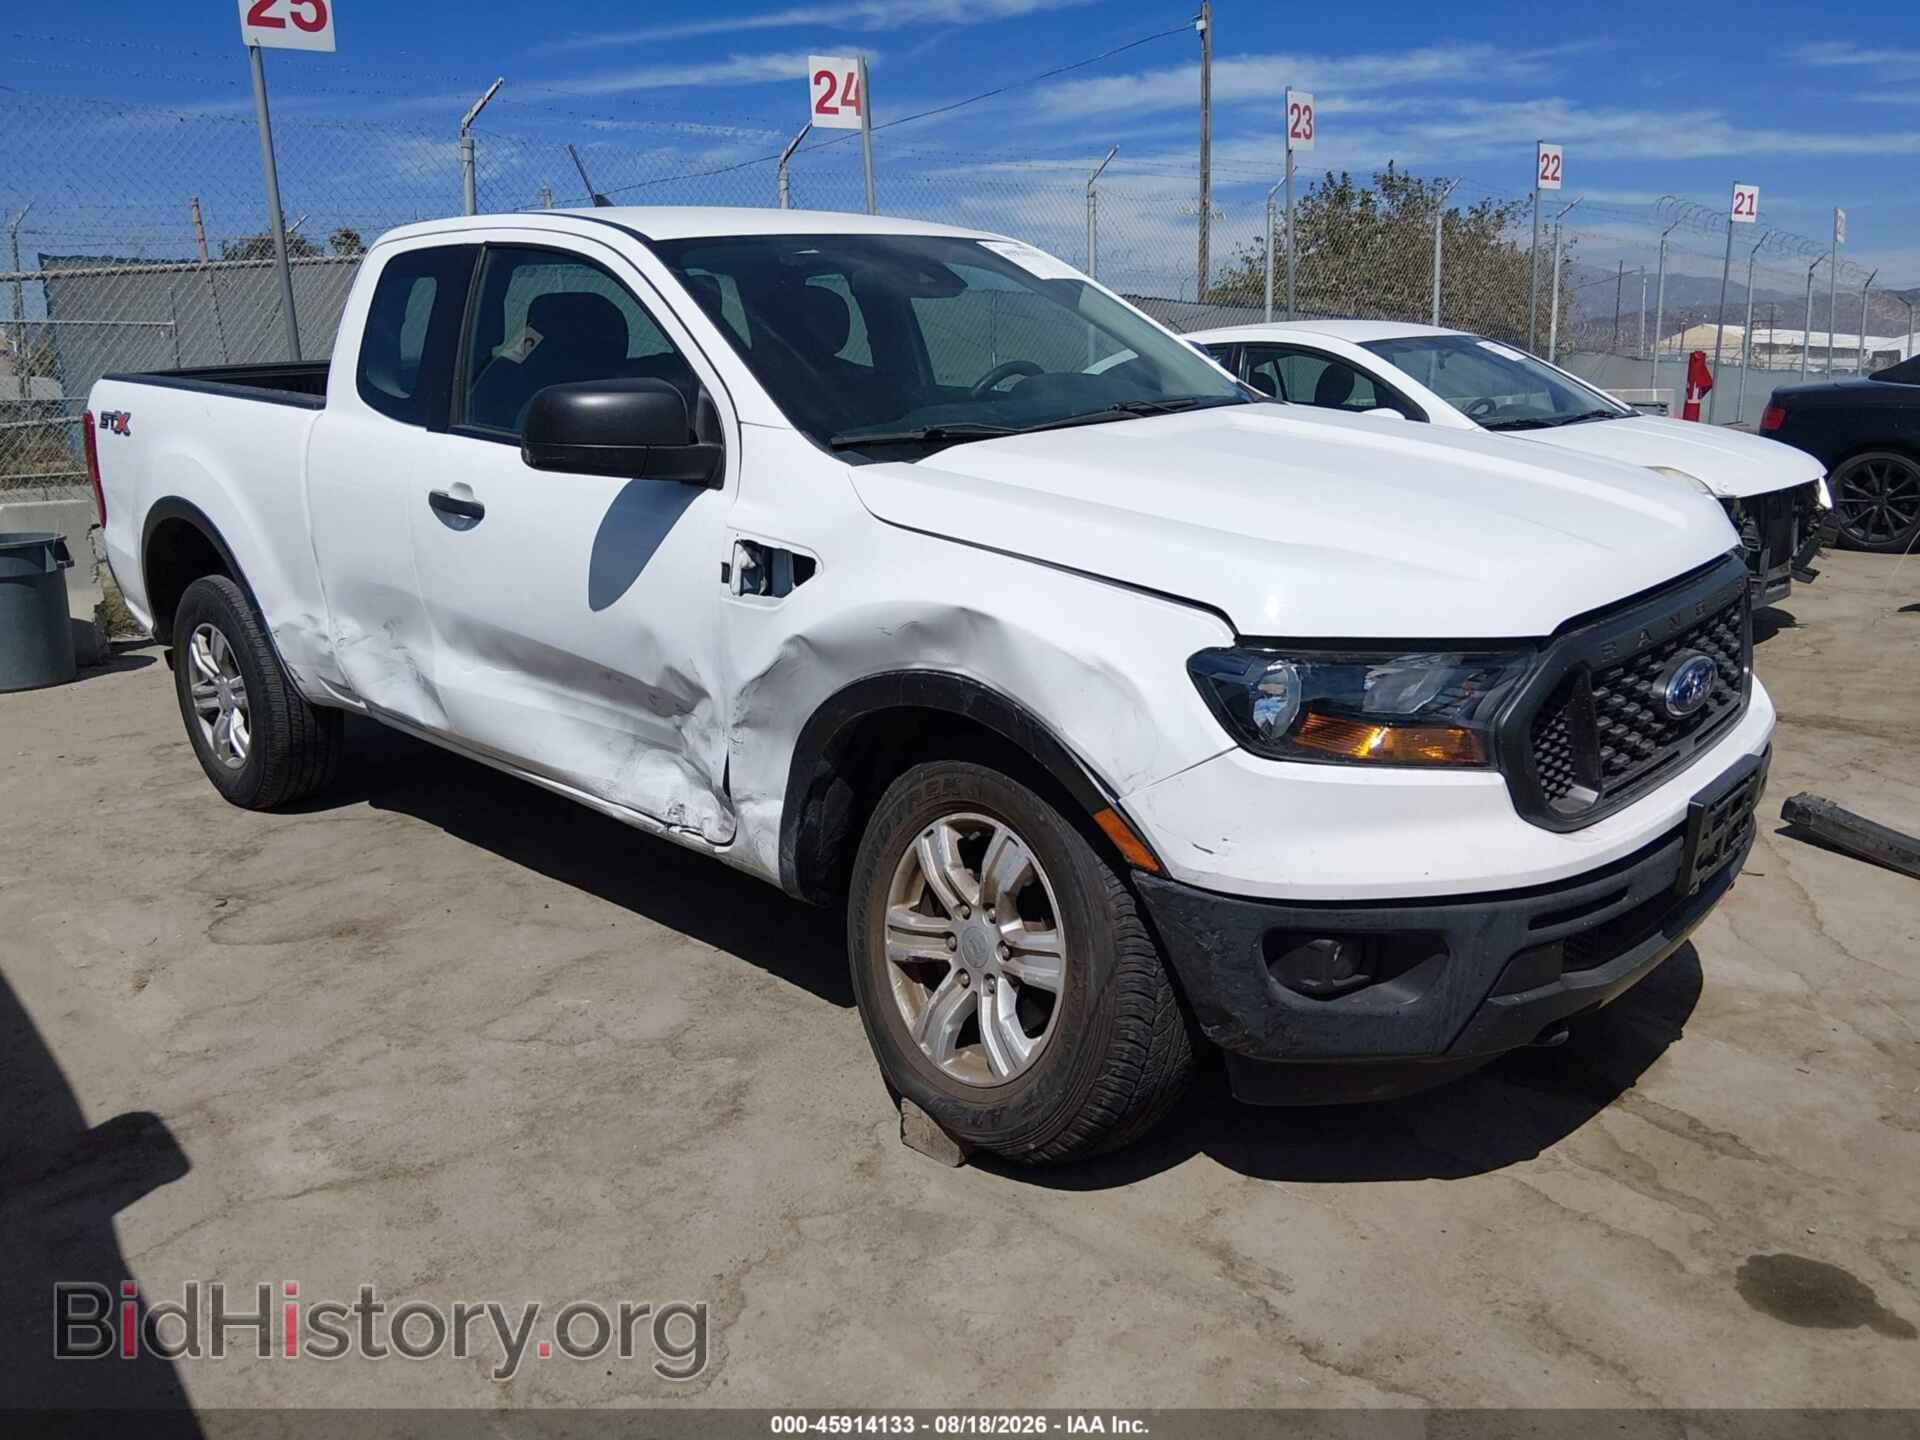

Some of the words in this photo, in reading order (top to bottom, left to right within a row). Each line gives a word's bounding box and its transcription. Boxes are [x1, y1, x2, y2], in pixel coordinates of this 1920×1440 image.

[814, 70, 862, 116] 24
[1290, 103, 1312, 140] 23
[1540, 153, 1560, 181] 22
[1734, 191, 1755, 216] 21
